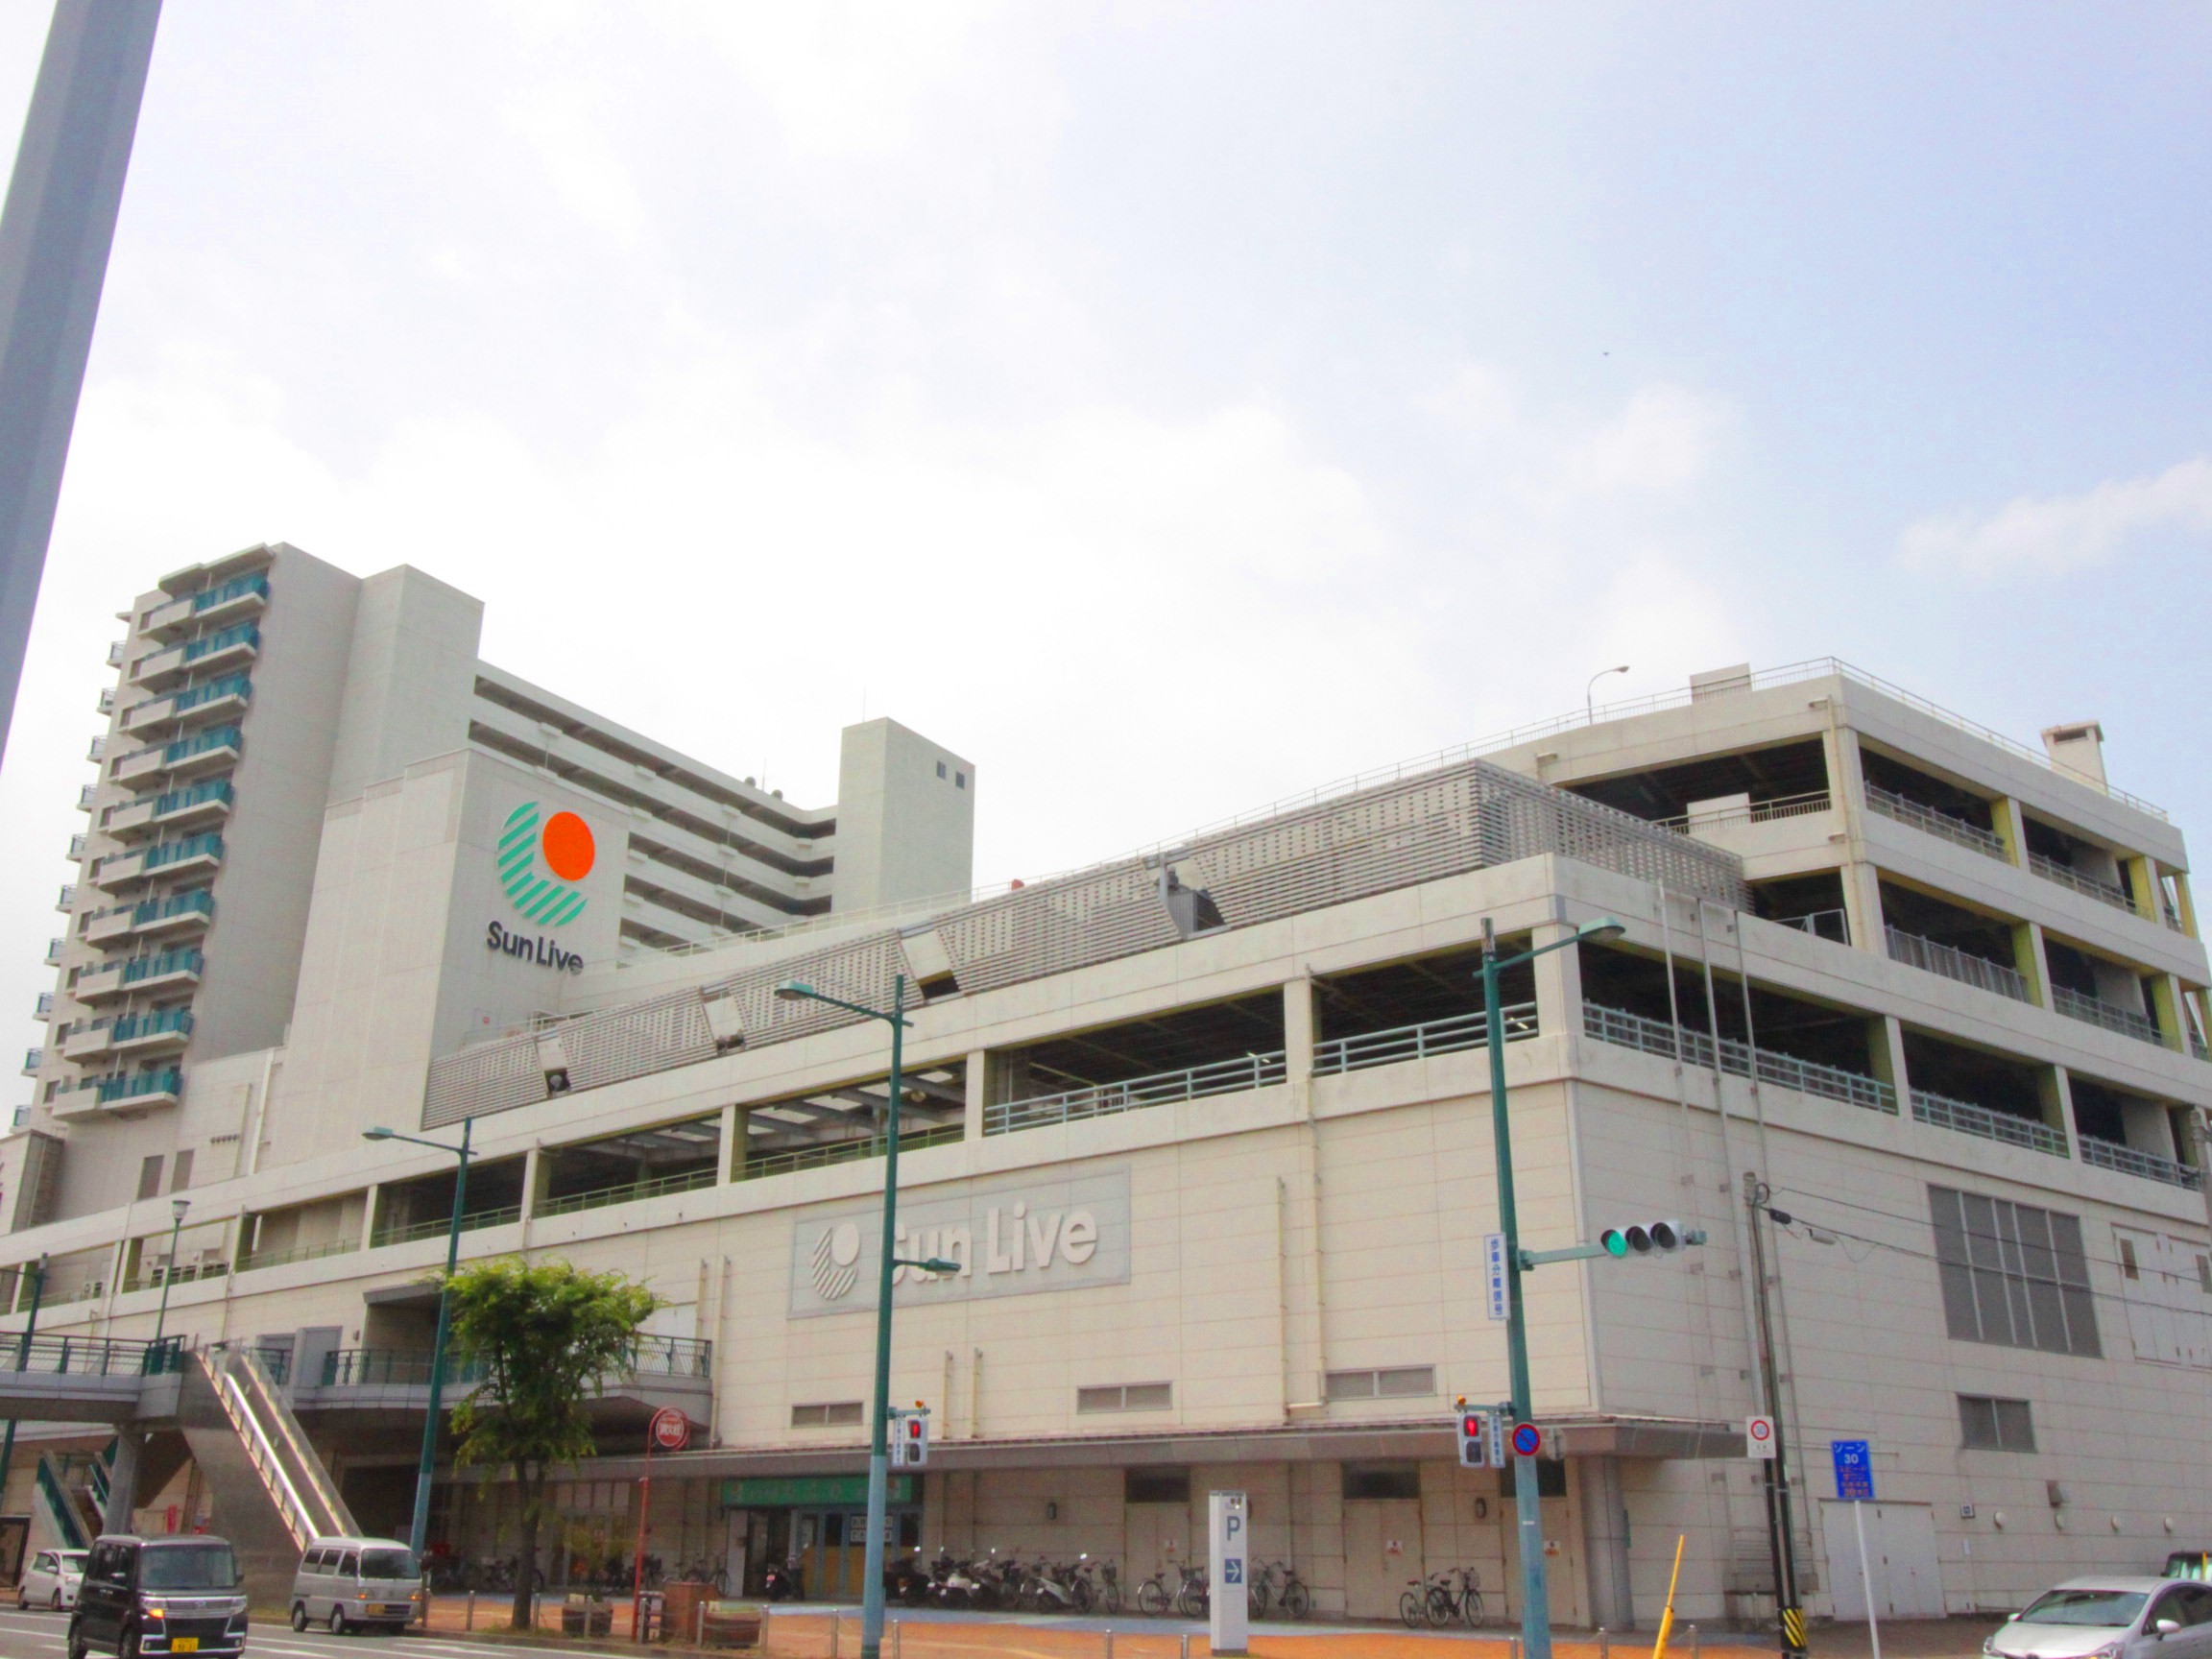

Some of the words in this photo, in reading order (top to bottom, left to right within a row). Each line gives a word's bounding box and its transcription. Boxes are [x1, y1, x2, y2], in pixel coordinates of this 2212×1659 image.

[987, 1202, 1097, 1275] Live
[1843, 1453, 1860, 1464] 30
[1227, 1515, 1241, 1541] P
